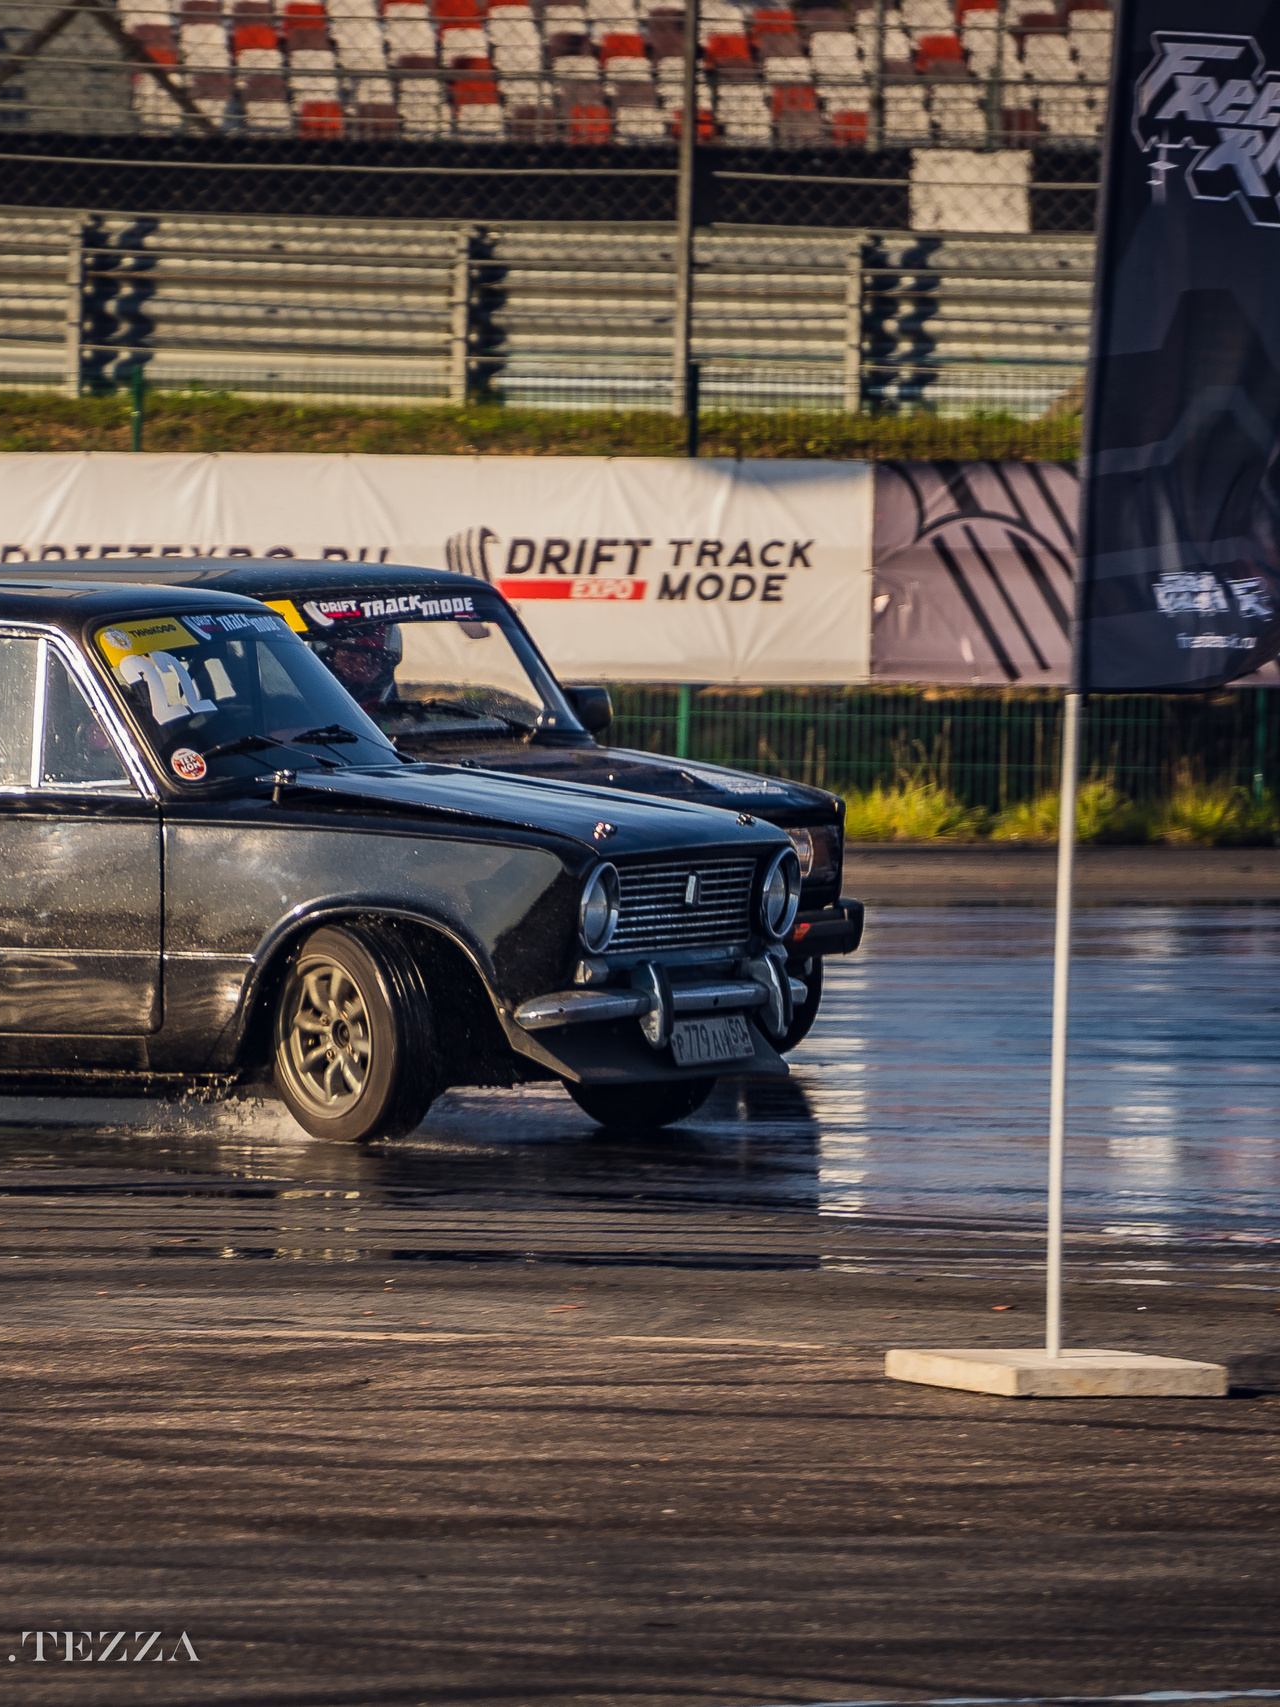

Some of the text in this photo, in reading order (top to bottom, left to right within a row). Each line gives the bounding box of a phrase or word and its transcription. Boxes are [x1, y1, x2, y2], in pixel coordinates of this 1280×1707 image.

[505, 537, 815, 575] DRIFT TRACK
[571, 572, 789, 601] EXPO MODE
[320, 600, 357, 613] DRIFT
[119, 651, 219, 726] 22
